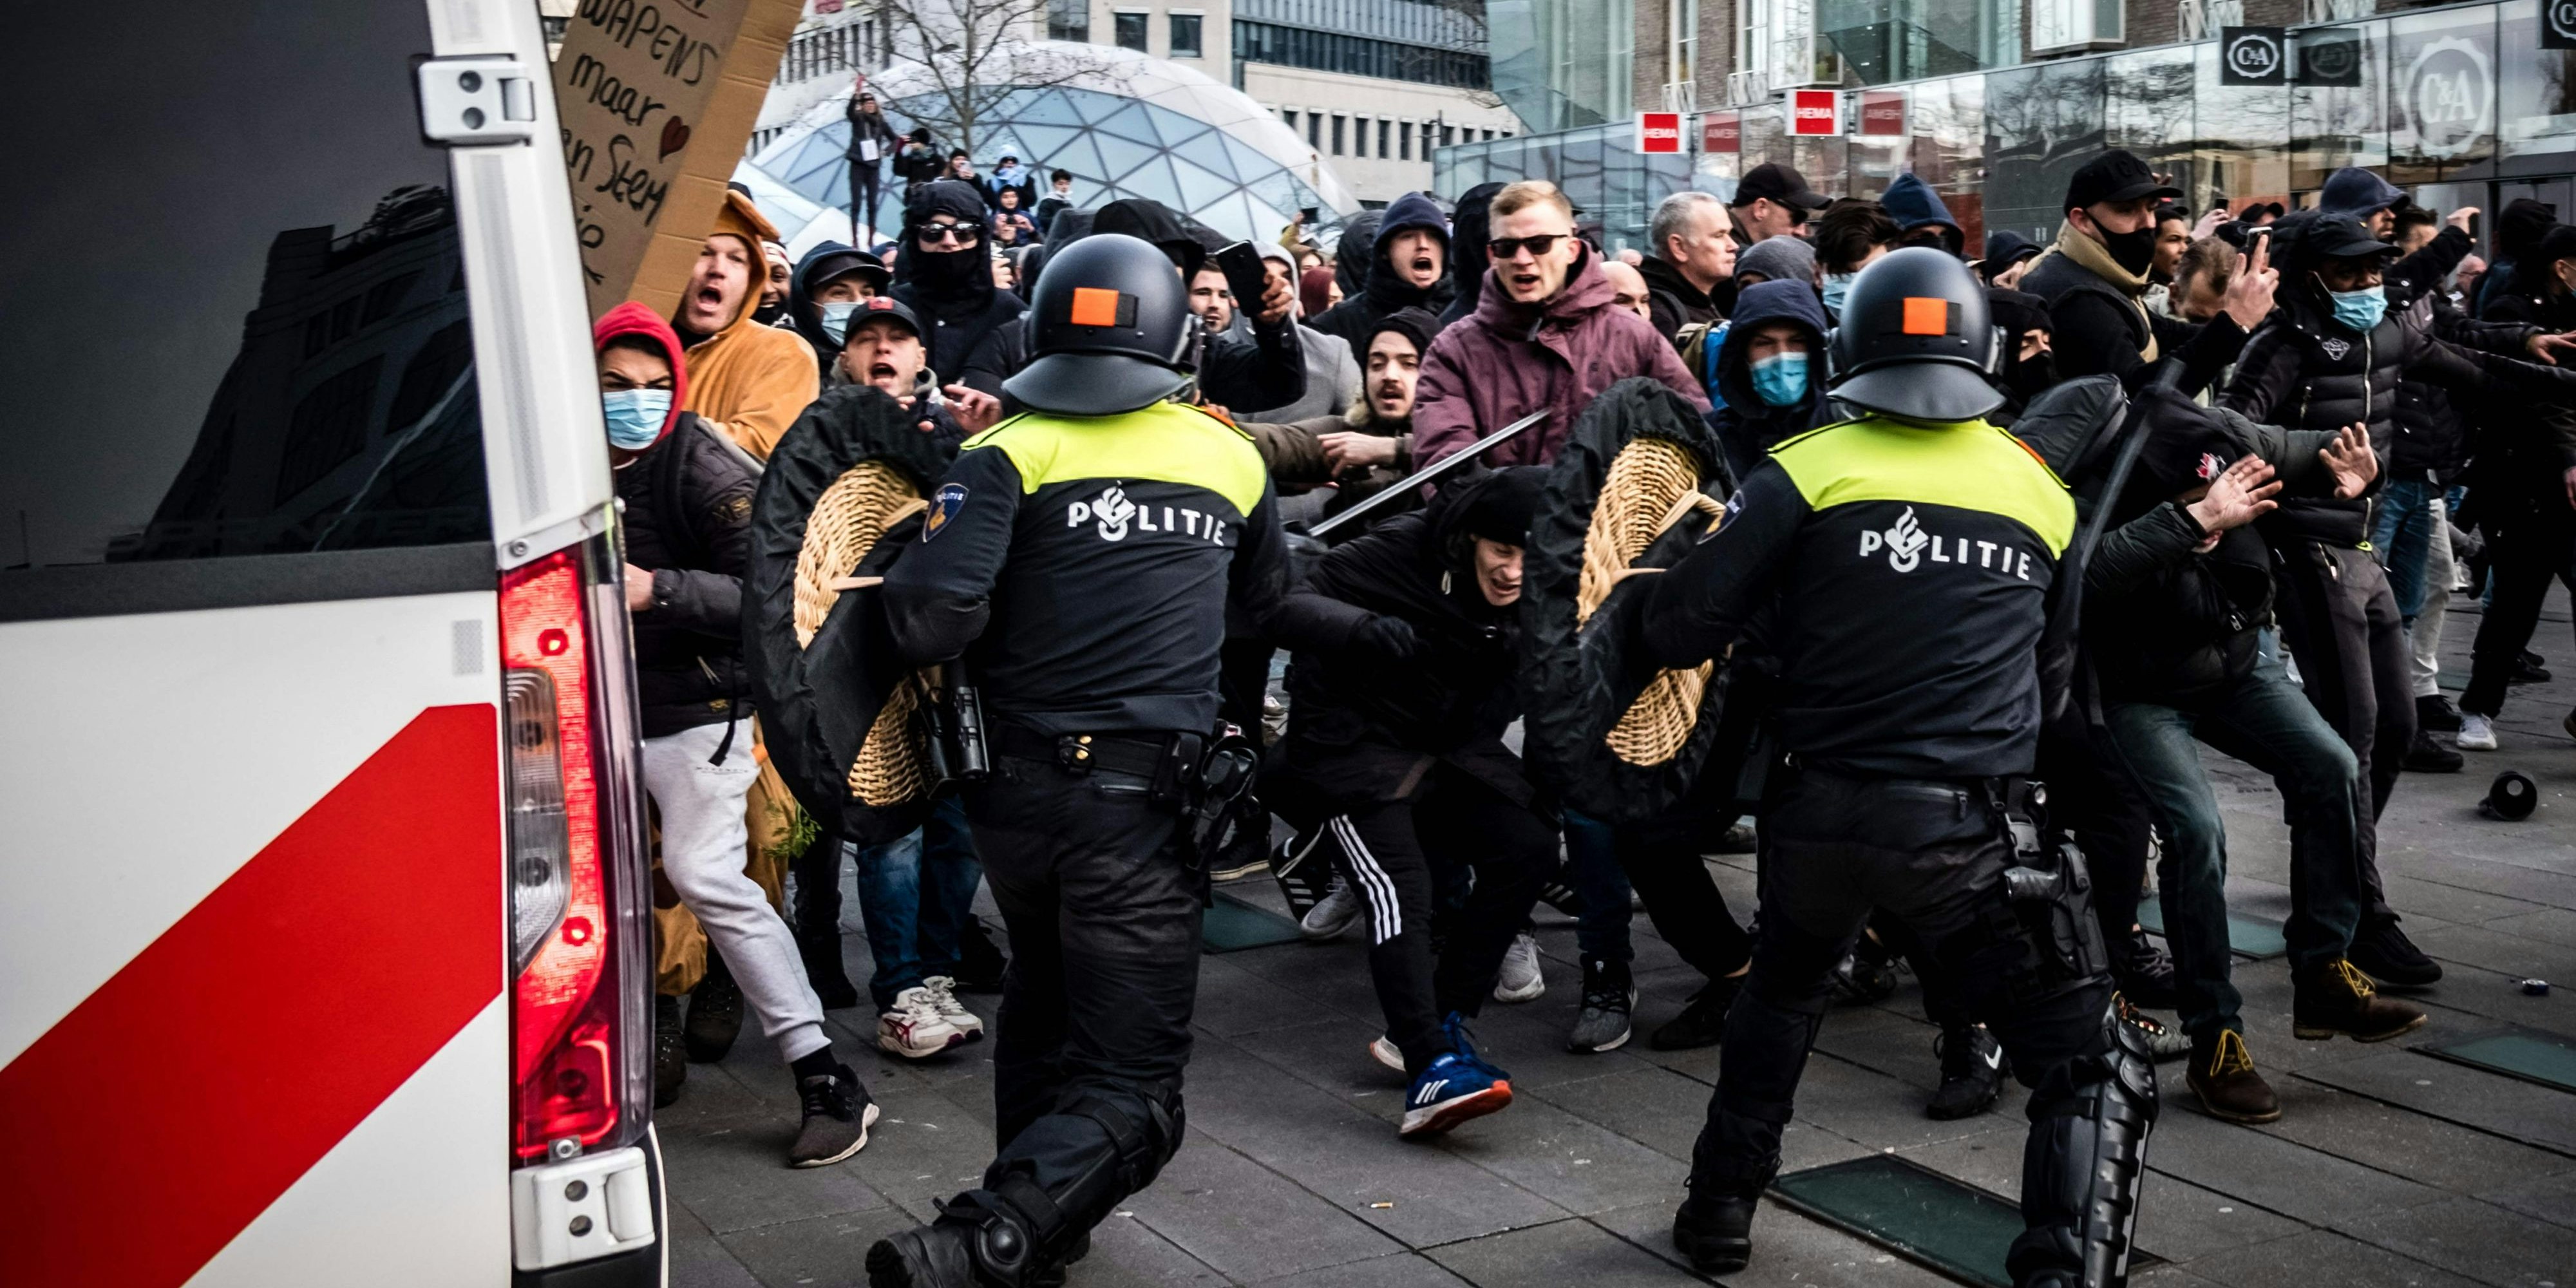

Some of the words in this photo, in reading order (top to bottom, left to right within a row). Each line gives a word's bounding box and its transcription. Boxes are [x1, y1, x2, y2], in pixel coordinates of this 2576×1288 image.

[579, 0, 719, 86] WAPENS
[2237, 46, 2271, 65] C&A
[569, 53, 666, 126] maar
[1795, 108, 1833, 119] HEMA
[2418, 69, 2477, 124] C&A
[1644, 128, 1678, 139] HEMA
[1067, 493, 1226, 547] POLITIE
[1859, 518, 2032, 582] POLITIE
